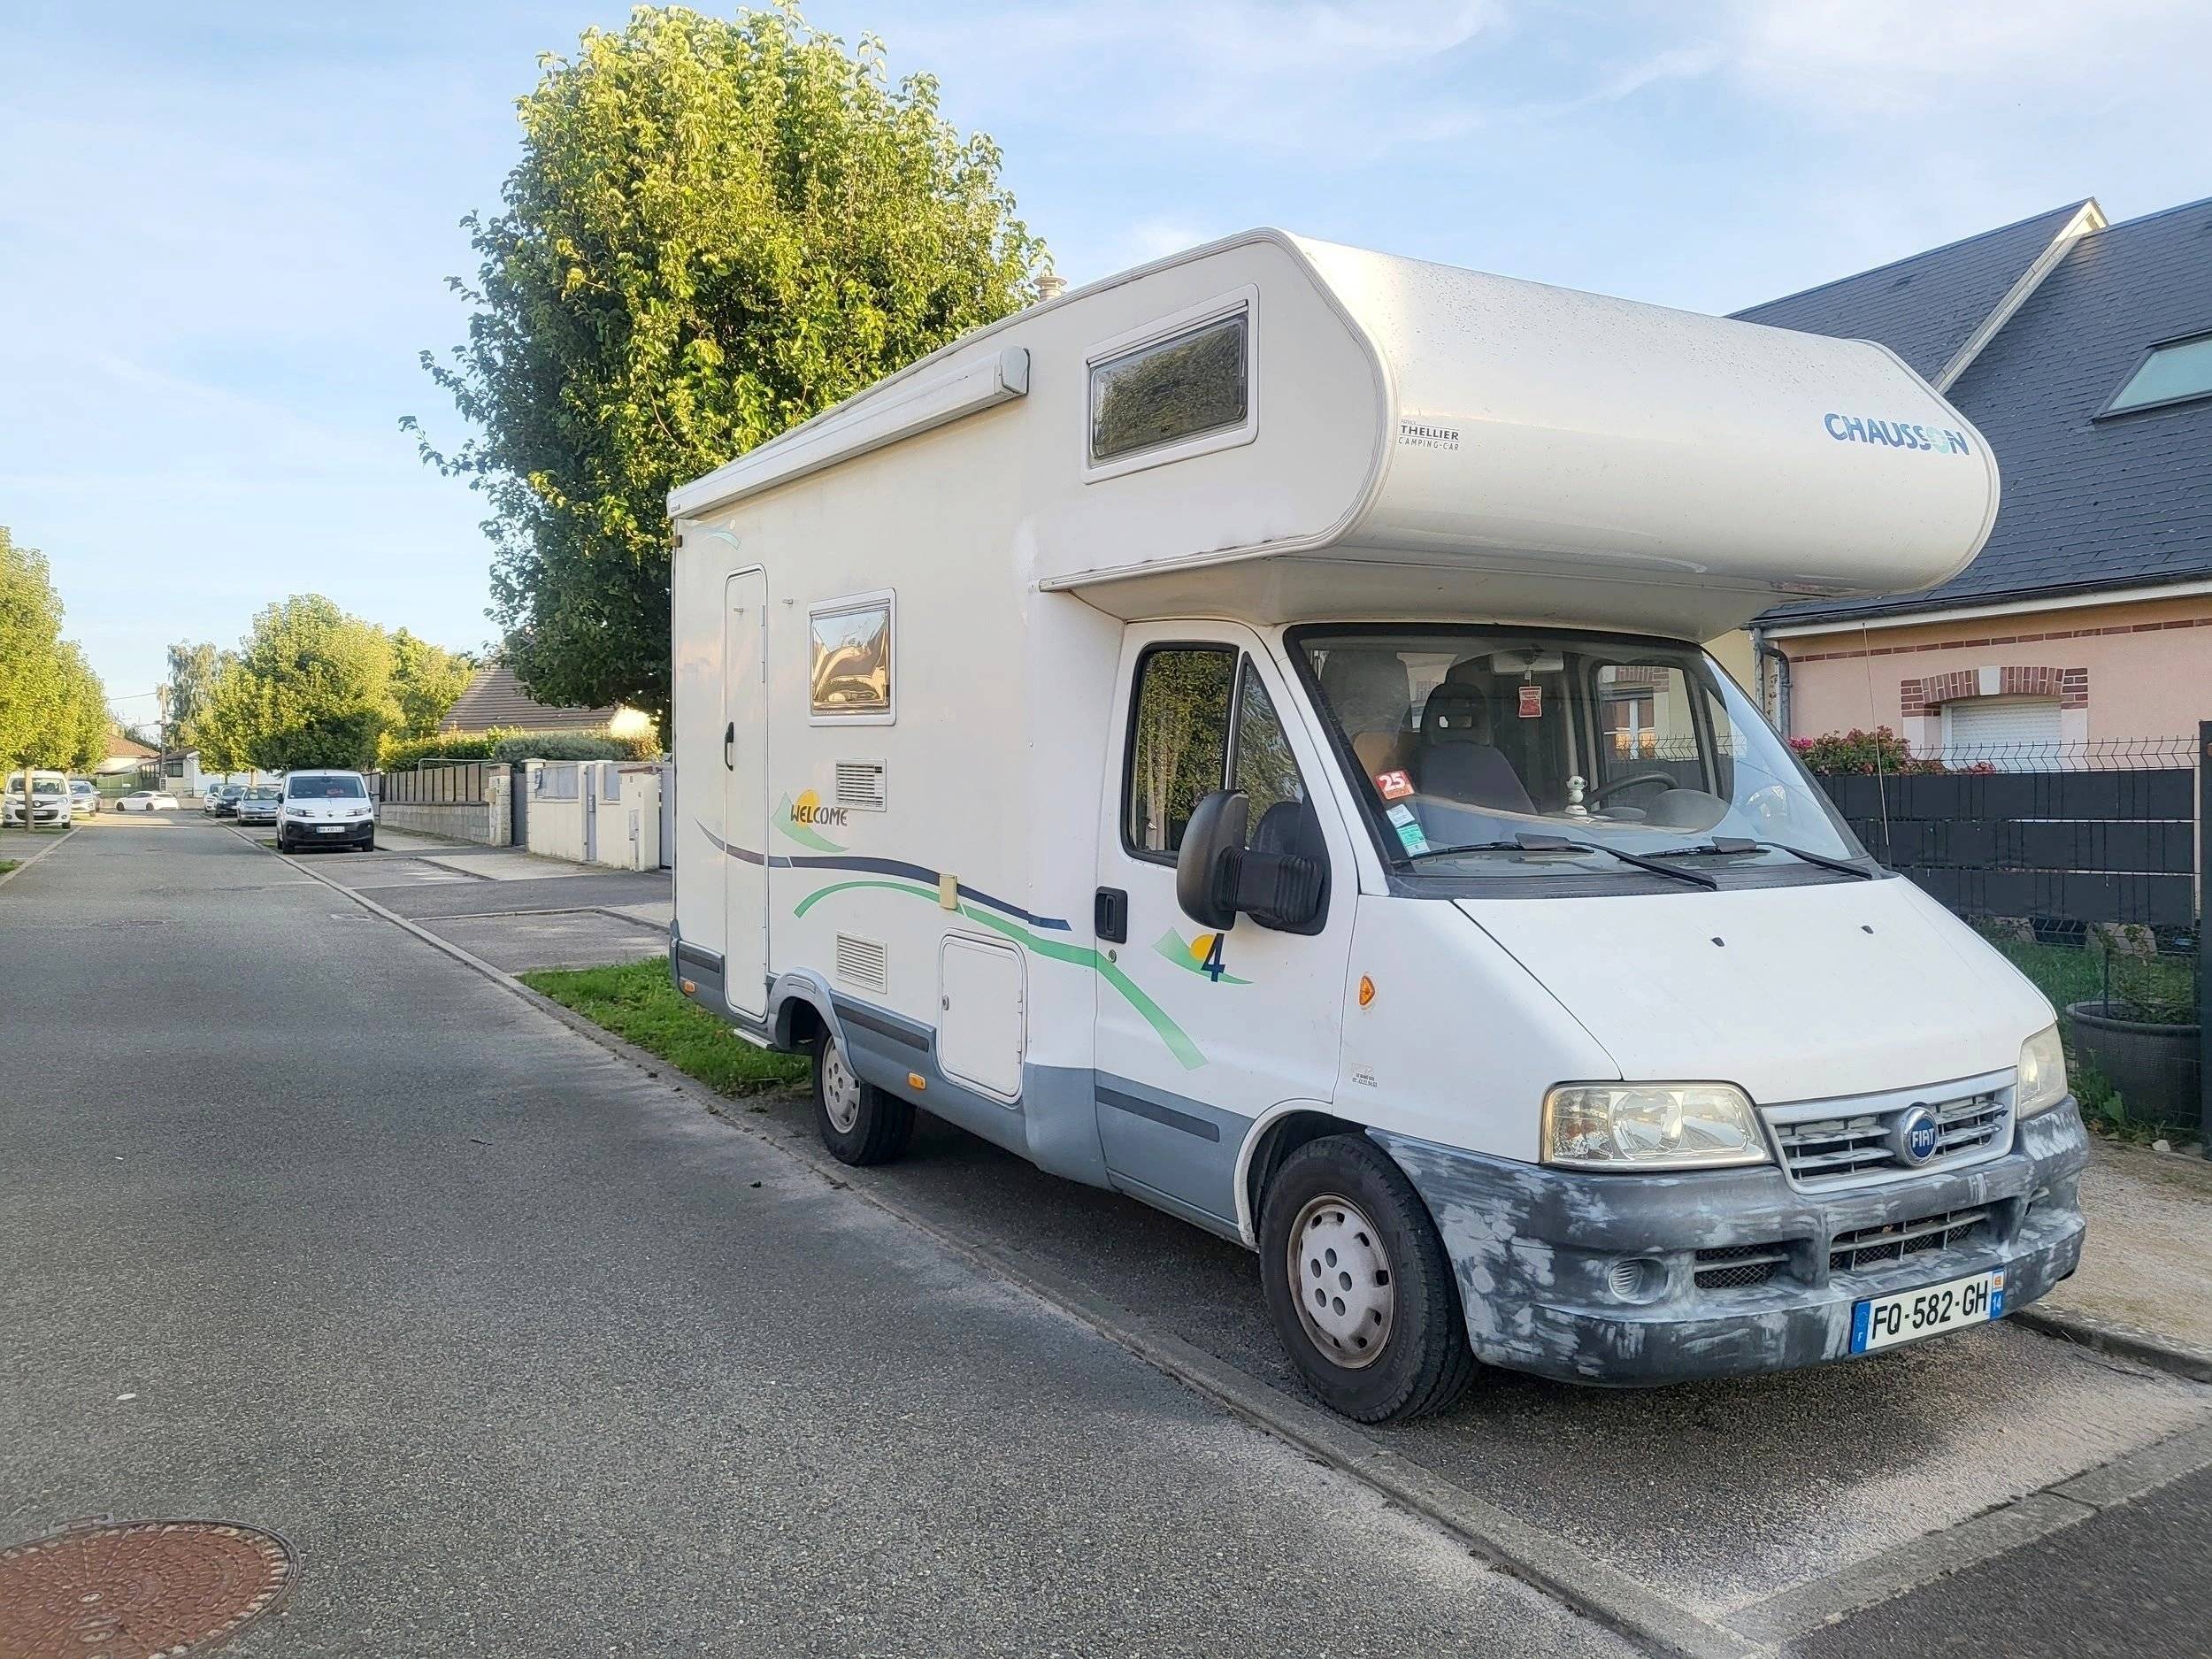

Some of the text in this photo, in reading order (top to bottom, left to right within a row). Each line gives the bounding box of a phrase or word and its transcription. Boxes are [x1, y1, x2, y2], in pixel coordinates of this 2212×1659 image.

[1401, 425, 1459, 441] THELLIER
[1824, 413, 1970, 456] CHAUSSON
[1398, 437, 1459, 451] CAMPING-CAR
[1379, 772, 1405, 791] 25
[790, 804, 848, 826] WELCOME
[1201, 933, 1225, 982] 4
[1912, 1128, 1934, 1148] FIAT
[1857, 1280, 2002, 1342] F FQ-582-GH 14
